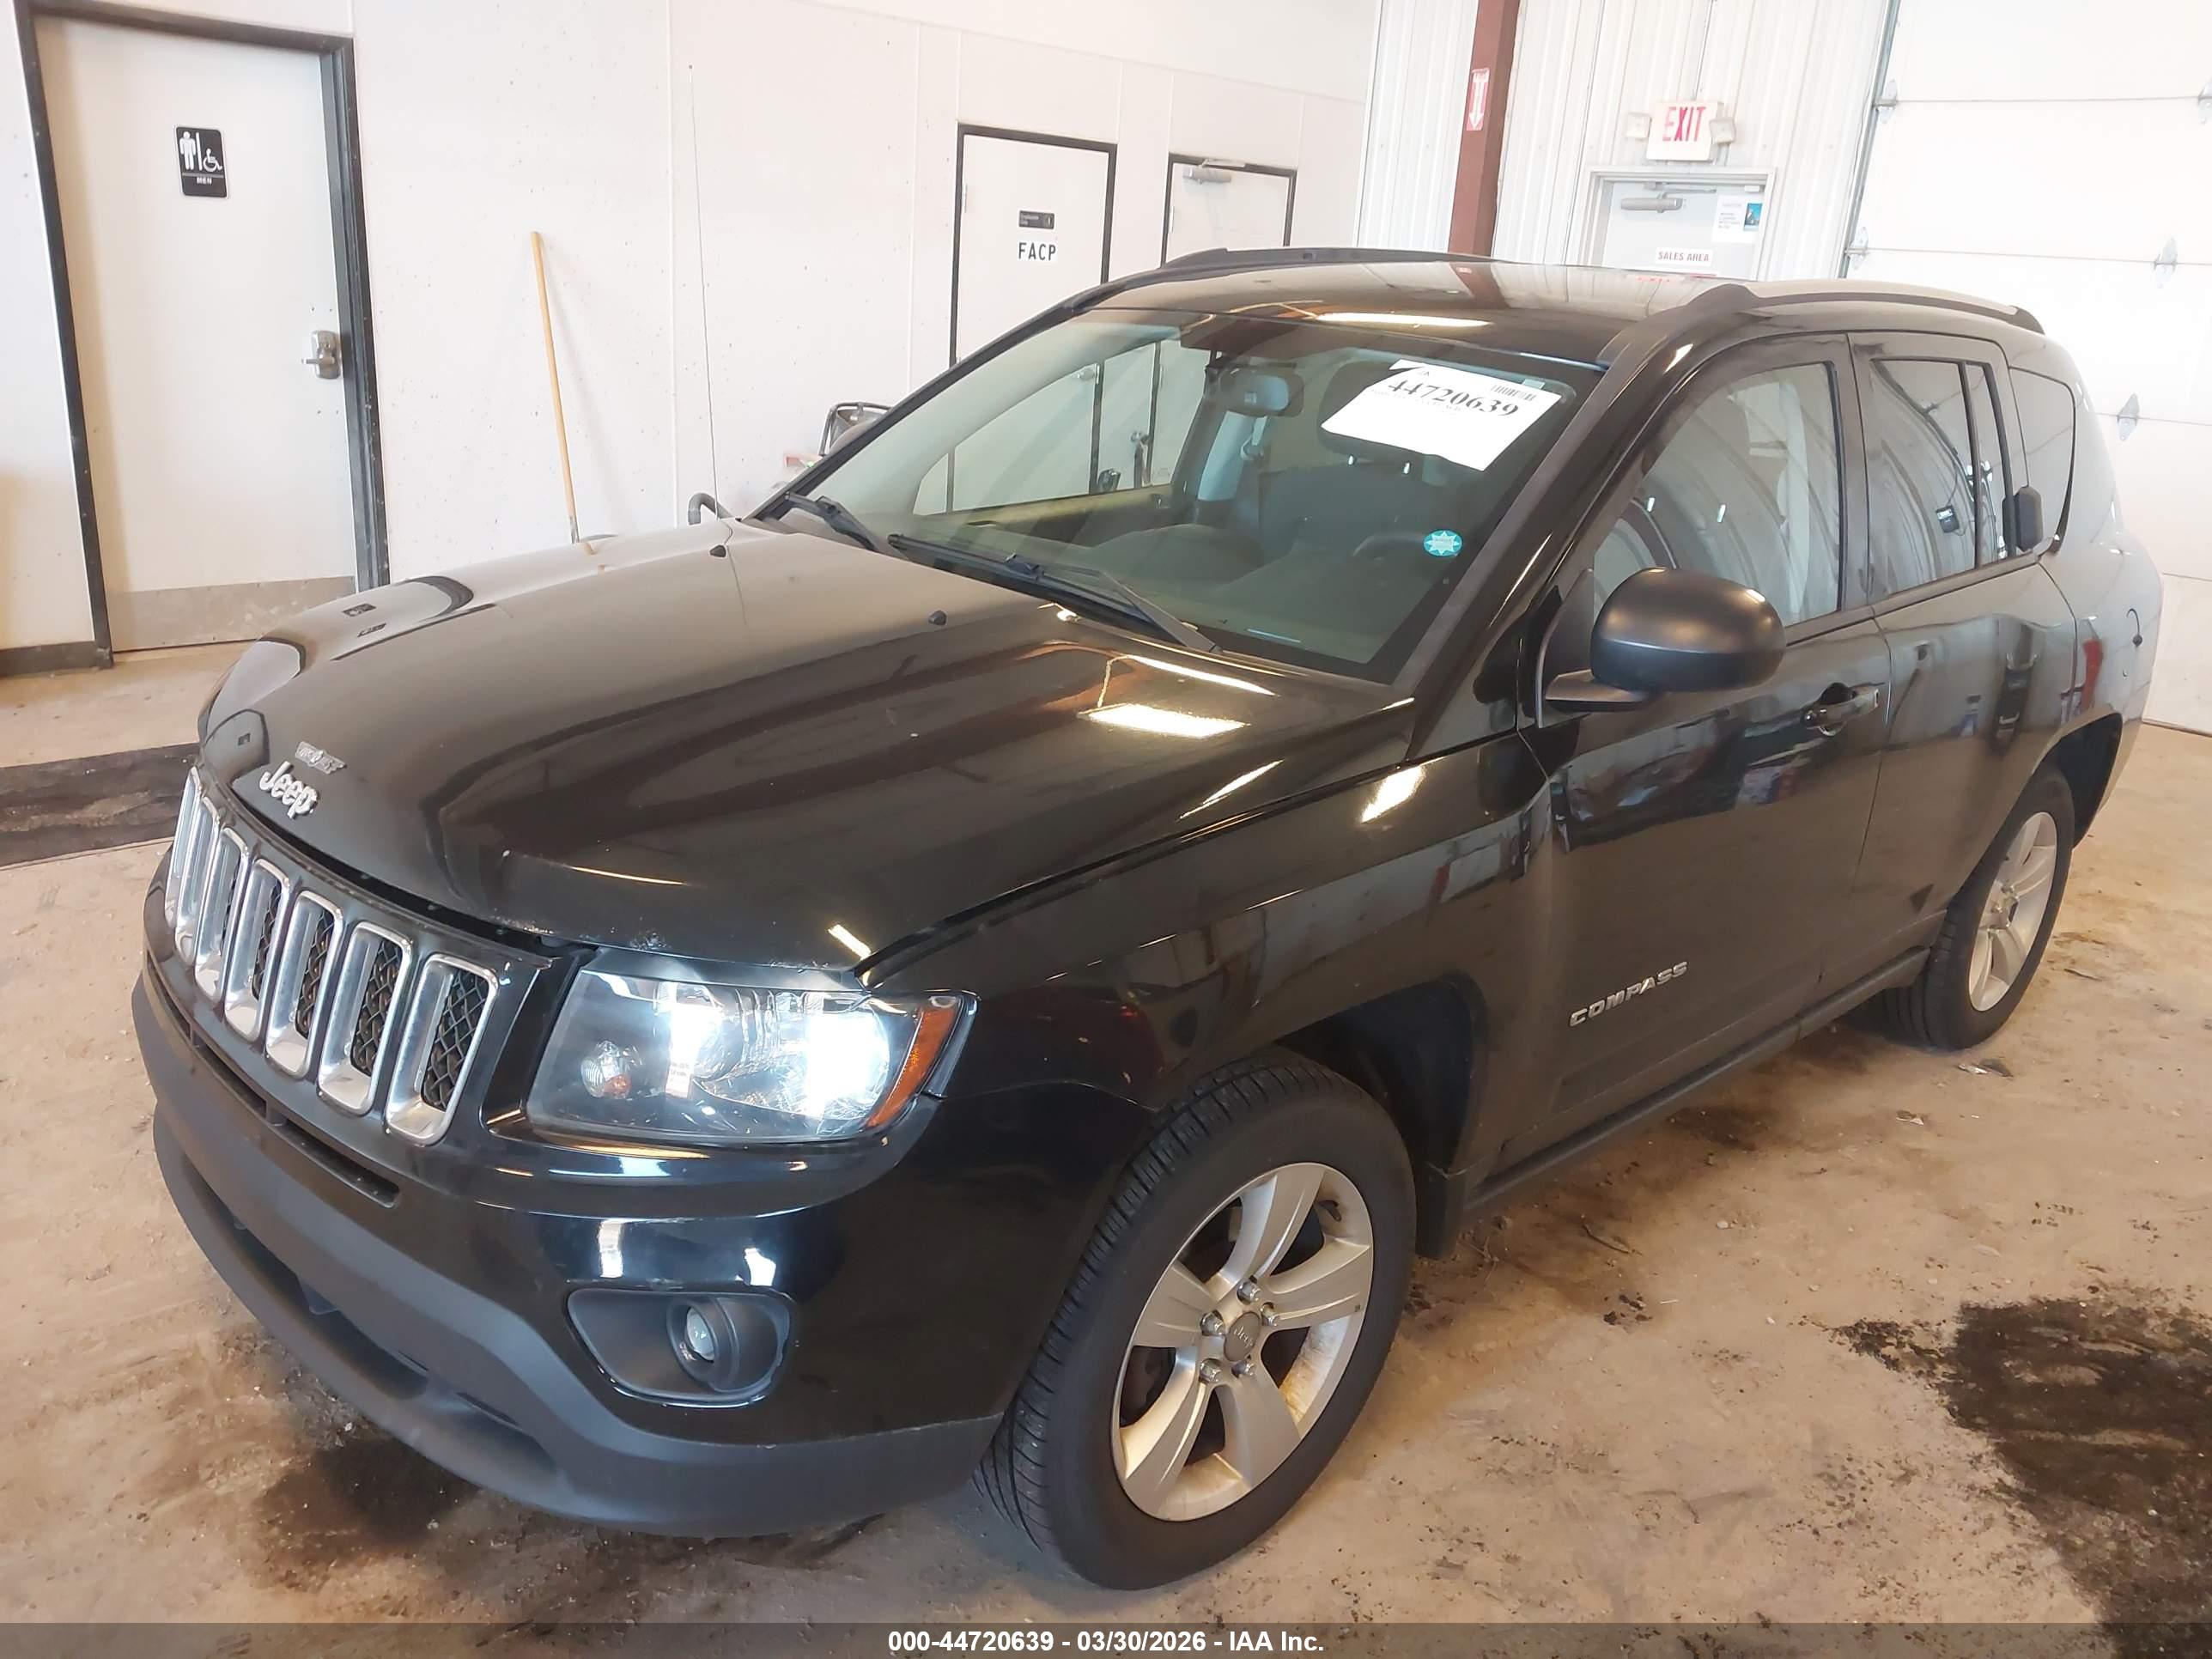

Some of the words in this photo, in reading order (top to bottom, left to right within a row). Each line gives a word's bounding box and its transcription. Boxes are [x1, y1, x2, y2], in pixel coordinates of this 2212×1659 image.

[1662, 106, 1705, 142] EXIT
[1018, 242, 1056, 261] FACP
[1658, 252, 1684, 261] SALES
[1686, 253, 1709, 262] AREA
[1388, 380, 1519, 416] 44720639
[259, 761, 317, 818] Jeep
[1570, 961, 1687, 1026] COMPASS
[1233, 1325, 1254, 1349] Jeep
